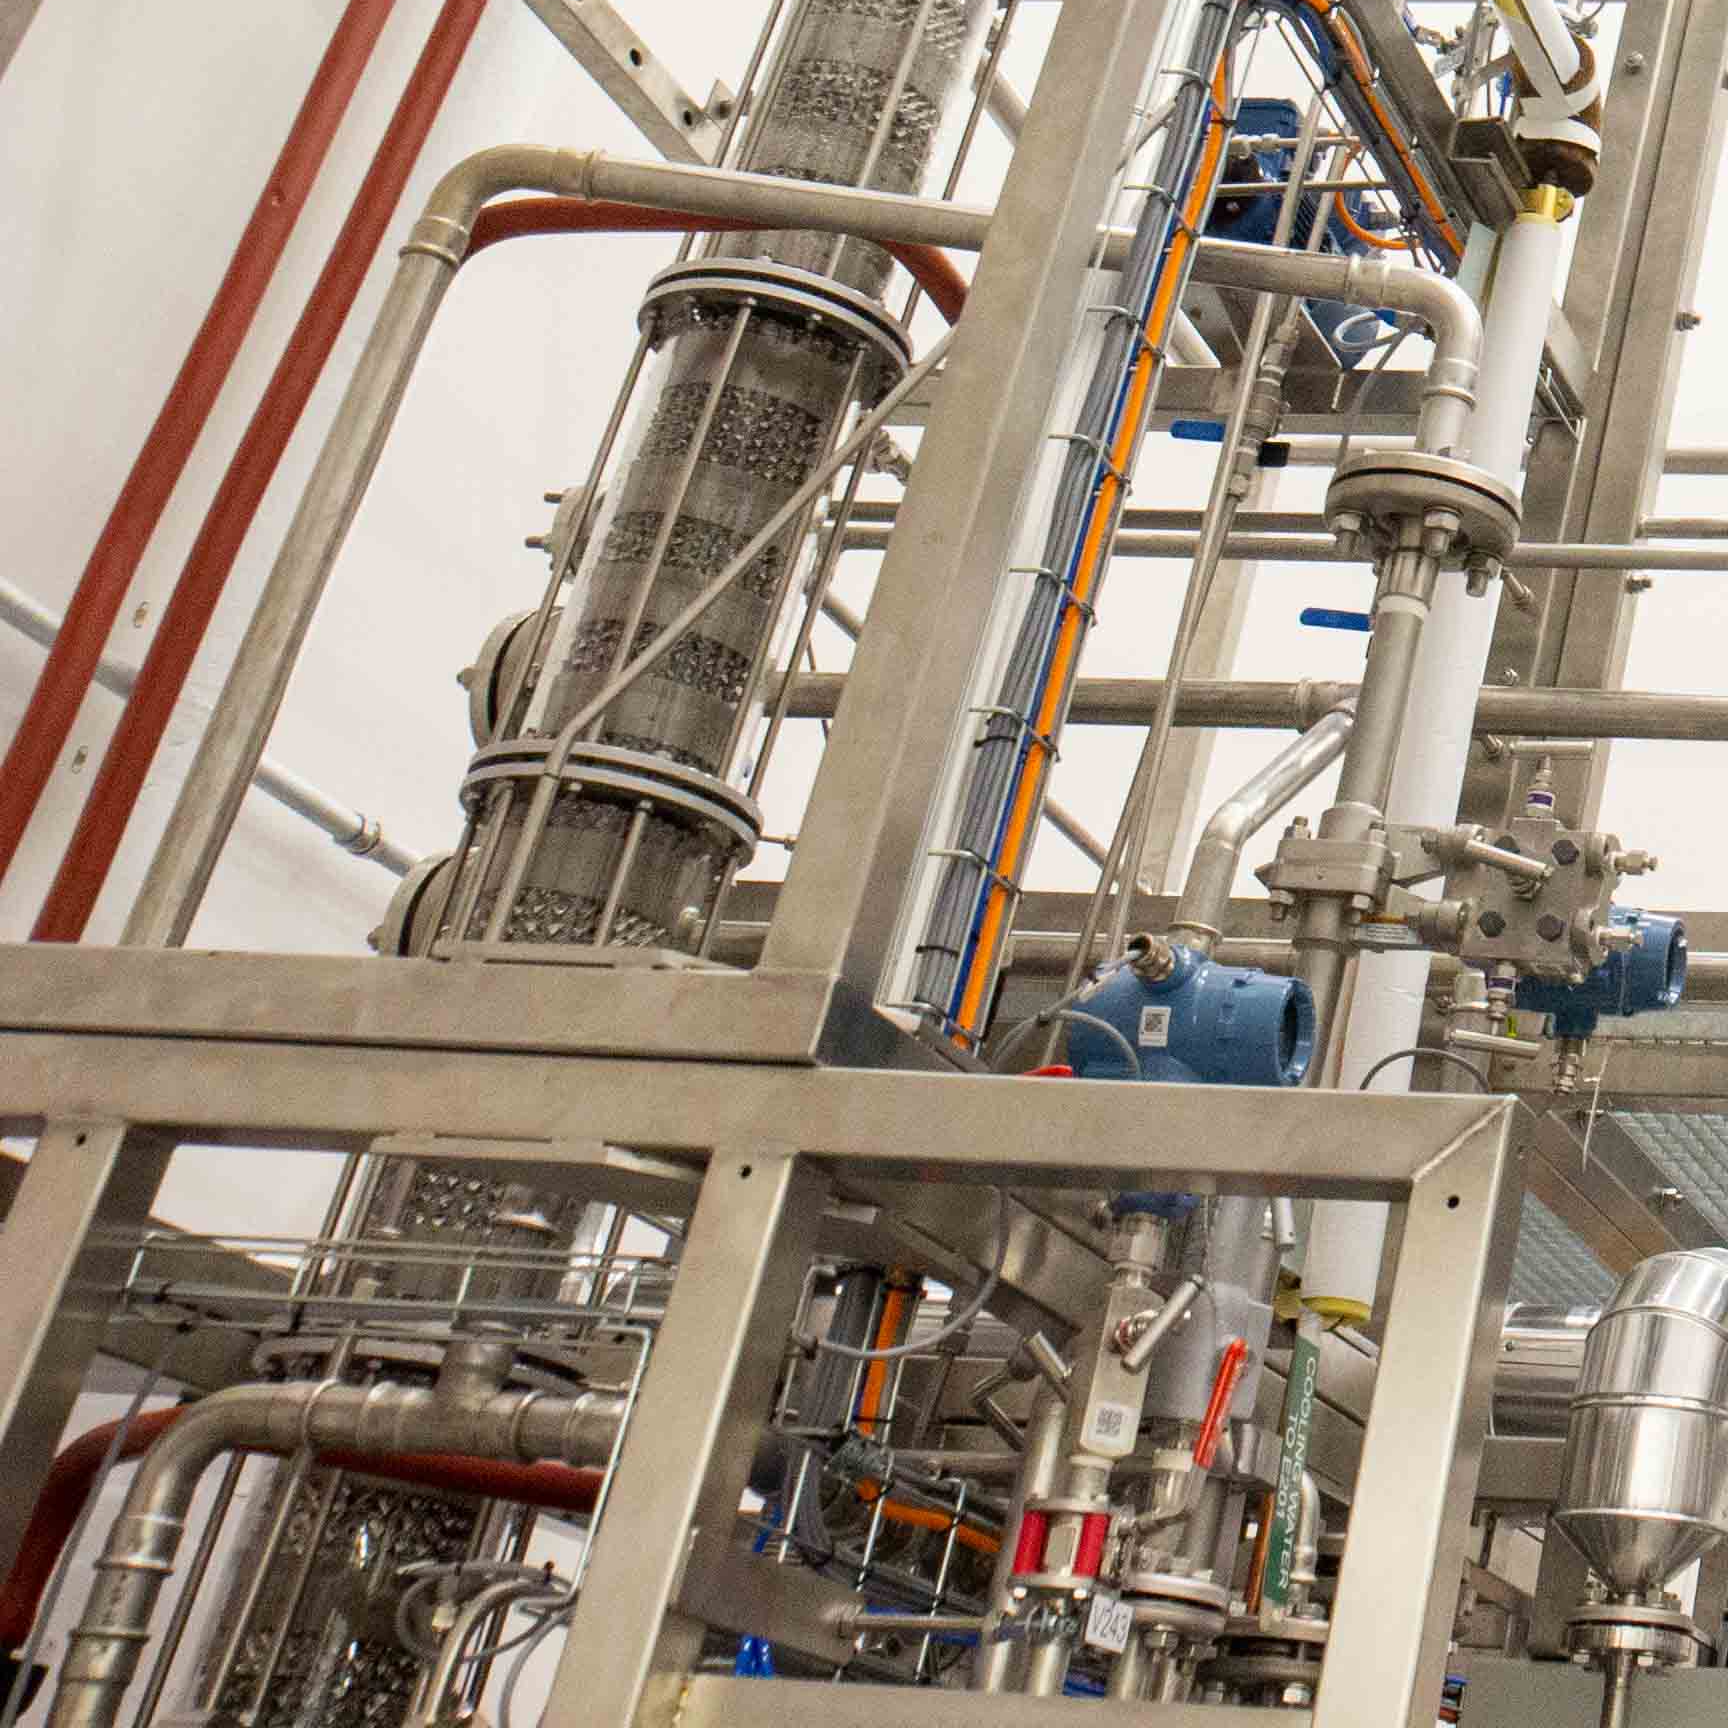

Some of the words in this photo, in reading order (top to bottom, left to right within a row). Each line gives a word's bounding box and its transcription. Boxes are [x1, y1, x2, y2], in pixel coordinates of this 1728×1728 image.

[1285, 1415, 1299, 1449] TO
[1292, 1357, 1316, 1482] COOLING
[1279, 1491, 1299, 1590] WATER
